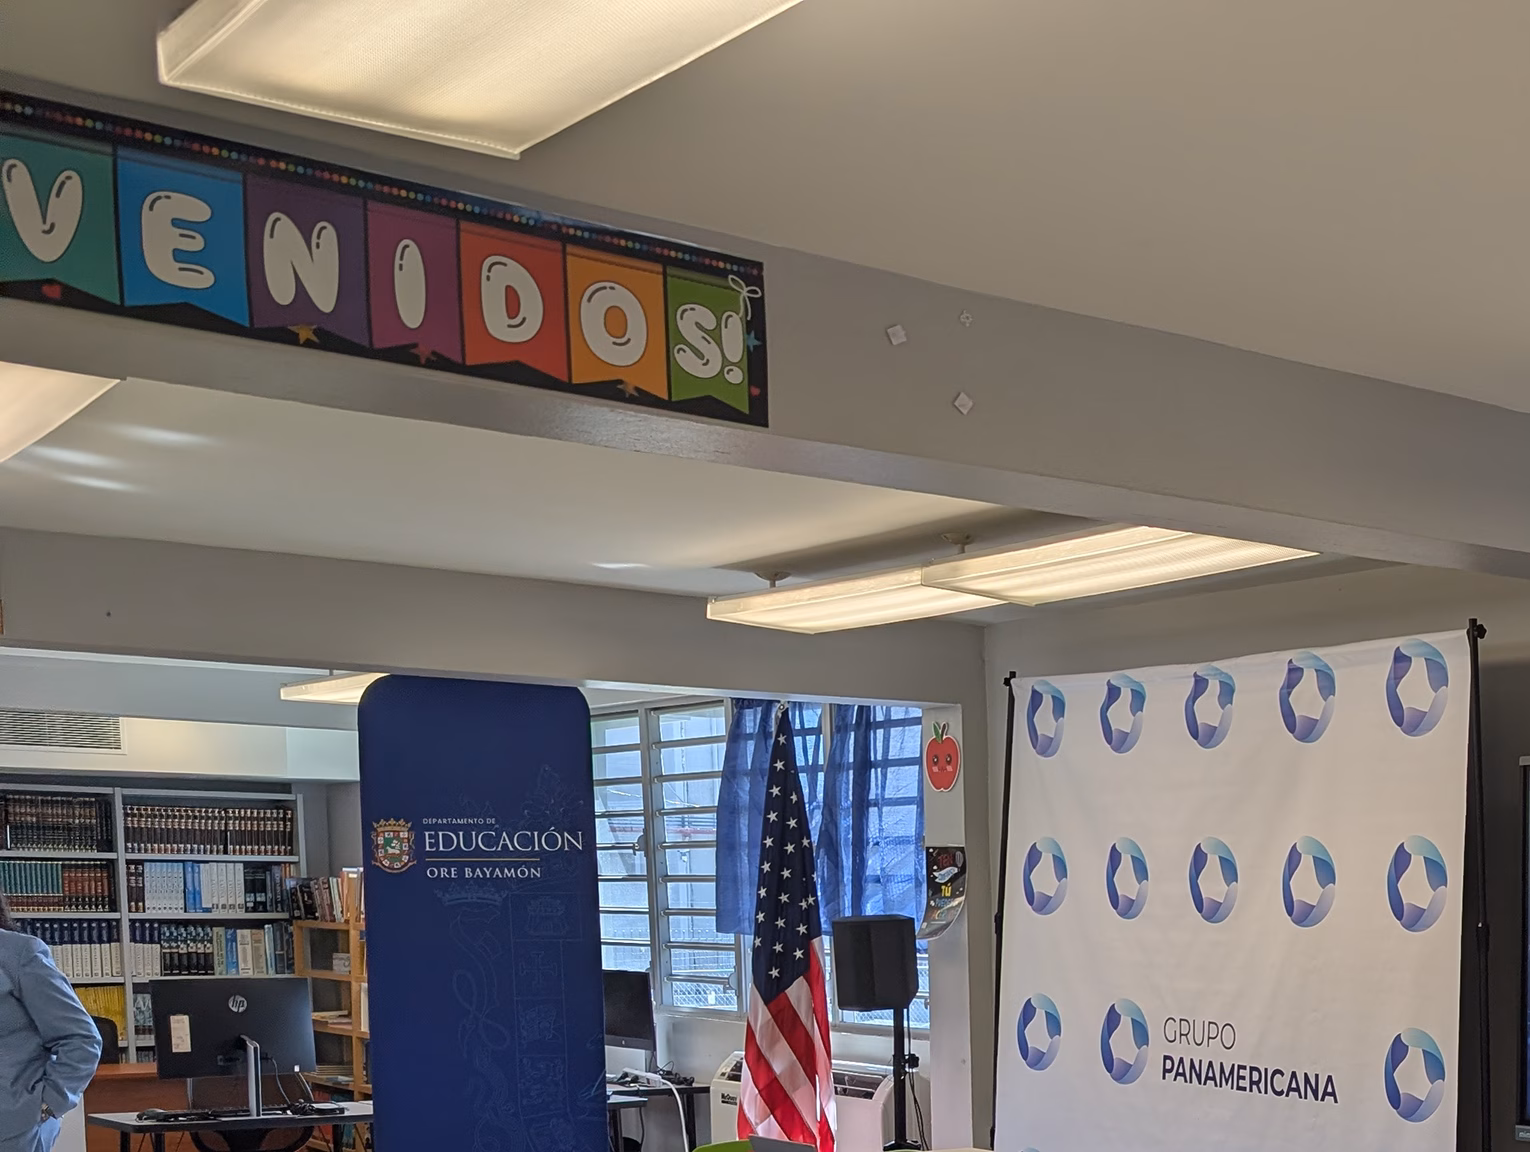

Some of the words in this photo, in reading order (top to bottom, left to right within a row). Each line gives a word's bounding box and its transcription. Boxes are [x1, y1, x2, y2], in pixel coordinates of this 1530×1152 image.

[422, 817, 485, 825] DEPARTAMENTO
[486, 817, 496, 825] DE
[424, 827, 583, 851] EDUCACIÓN
[426, 867, 459, 879] ORE
[464, 865, 541, 879] BAYAMÓN
[1163, 1016, 1237, 1051] GRUPO
[1161, 1054, 1339, 1104] PANAMERICANA
